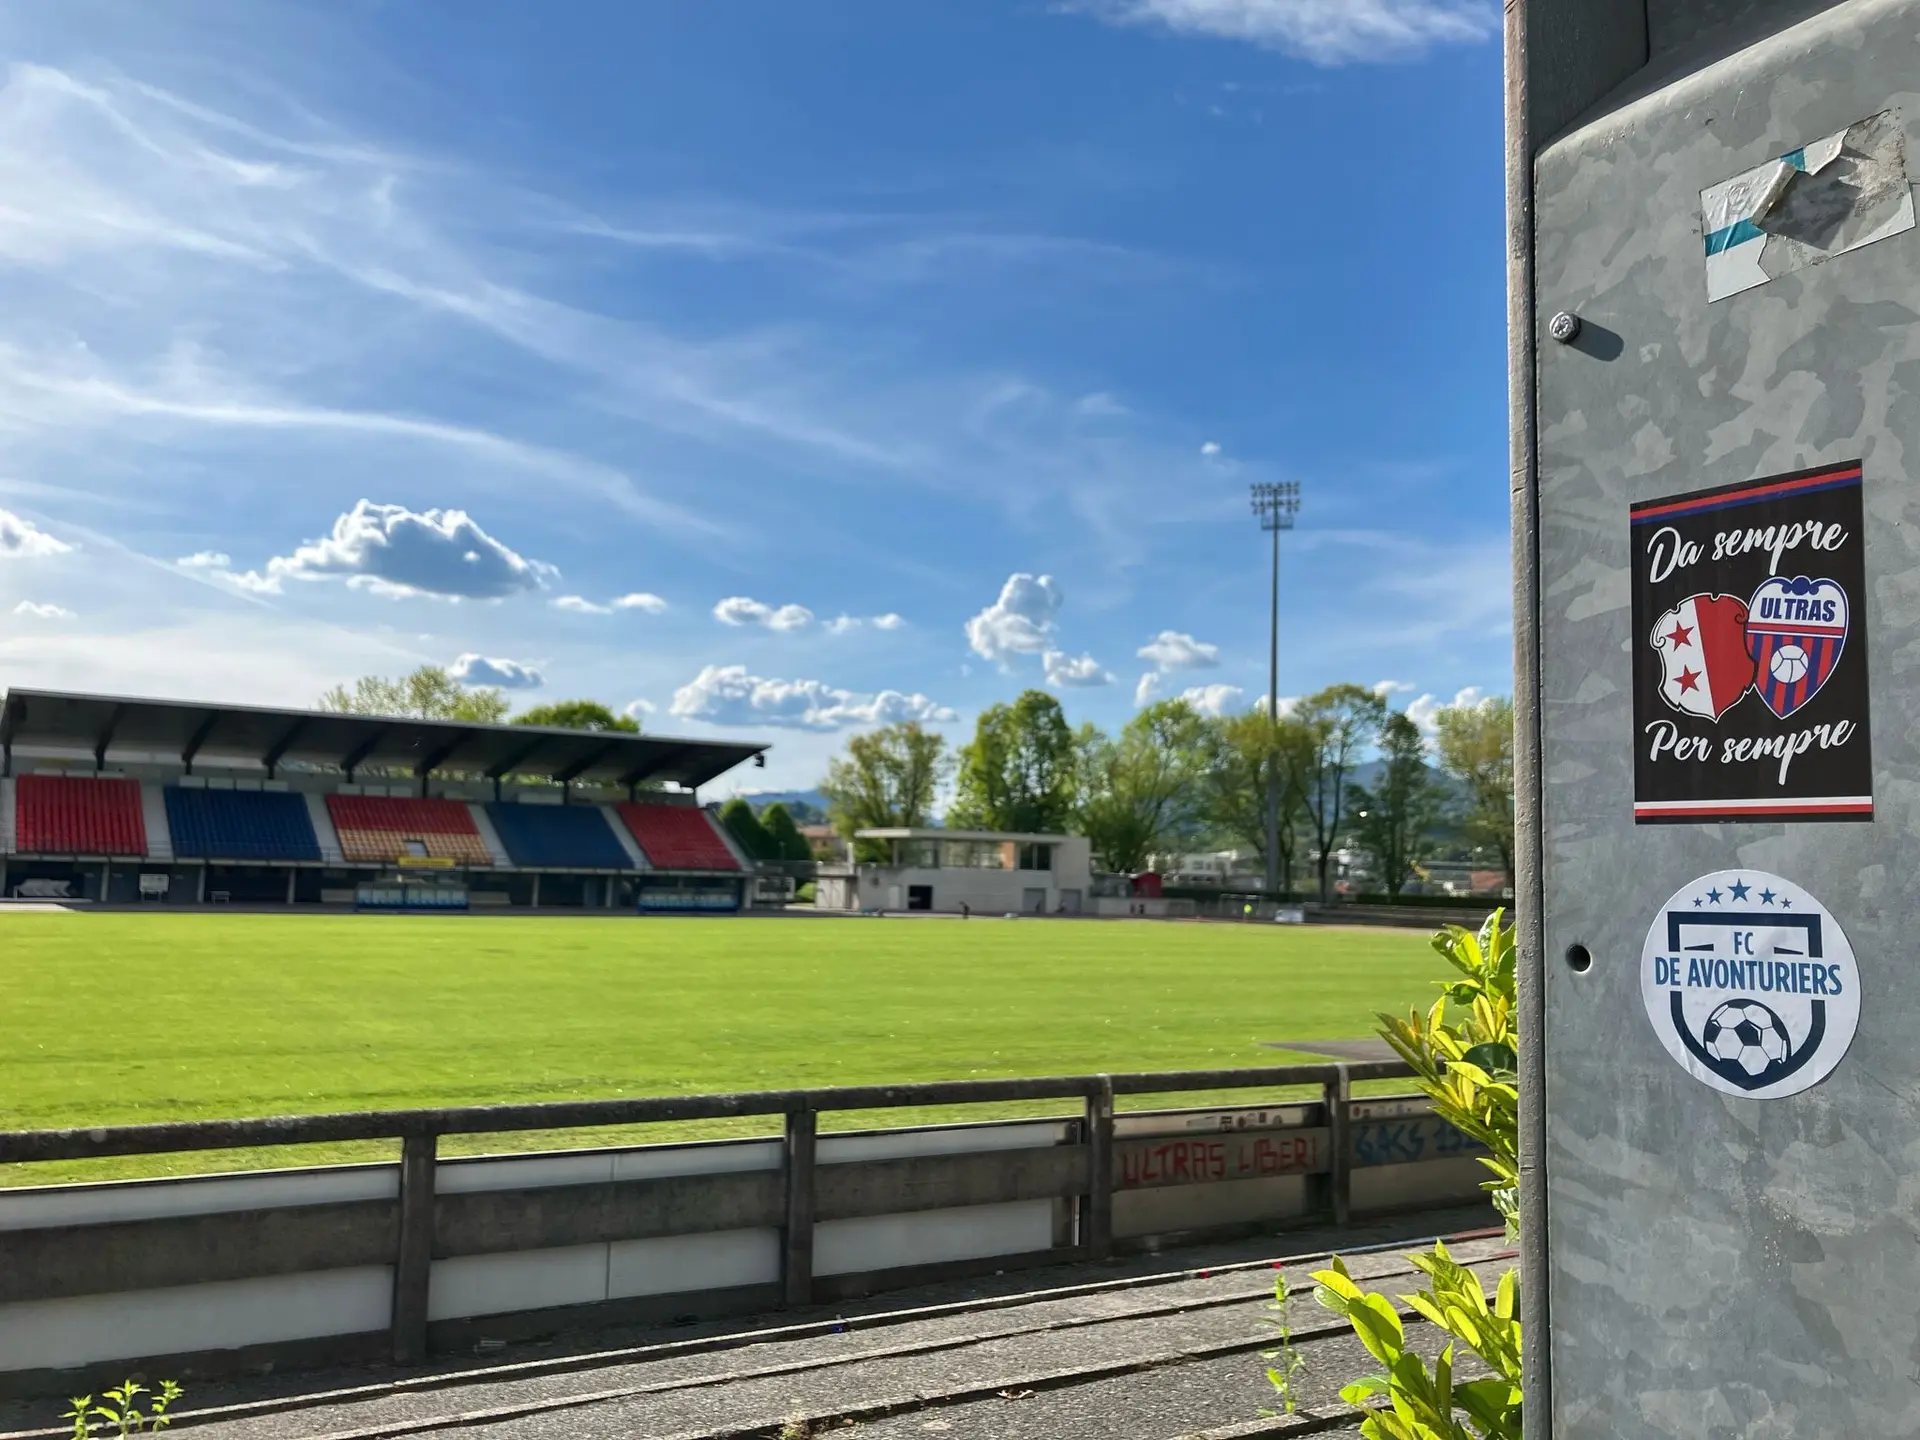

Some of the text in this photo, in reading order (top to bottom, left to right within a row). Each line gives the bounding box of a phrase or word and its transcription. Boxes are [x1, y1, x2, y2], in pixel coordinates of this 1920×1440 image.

[1647, 519, 1850, 584] Da sempre
[1760, 597, 1836, 622] ULTRAS
[1645, 718, 1857, 786] Per sempre
[1733, 931, 1754, 955] FC
[1655, 957, 1843, 996] DE AVONTURIERS
[1122, 1141, 1226, 1190] ULTRAS
